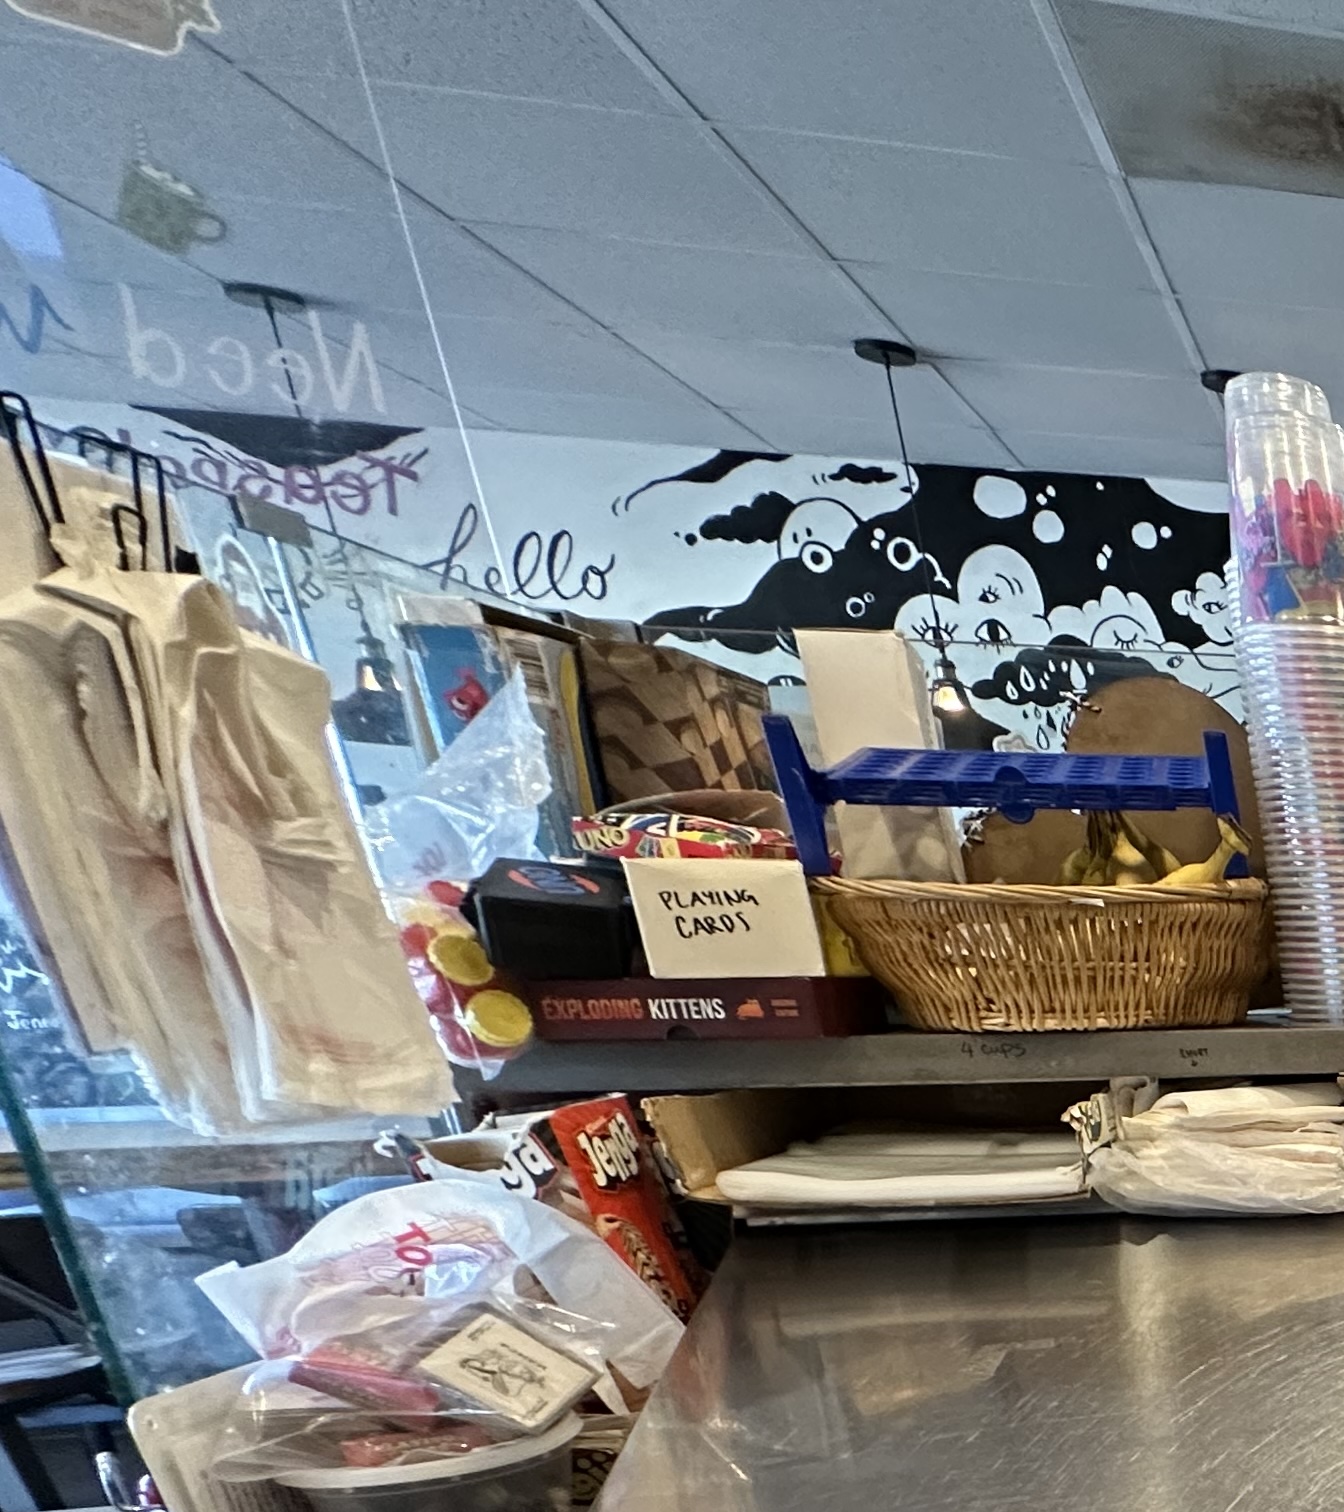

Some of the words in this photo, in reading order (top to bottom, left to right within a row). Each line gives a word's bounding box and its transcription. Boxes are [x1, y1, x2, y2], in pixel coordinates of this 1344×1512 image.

[420, 502, 616, 600] hello
[574, 825, 630, 853] UNO
[658, 889, 760, 910] PLAYING
[675, 911, 752, 939] CARDS
[542, 1000, 644, 1021] EXPLODING
[648, 997, 726, 1020] KITTENS
[577, 1111, 639, 1188] Jenga
